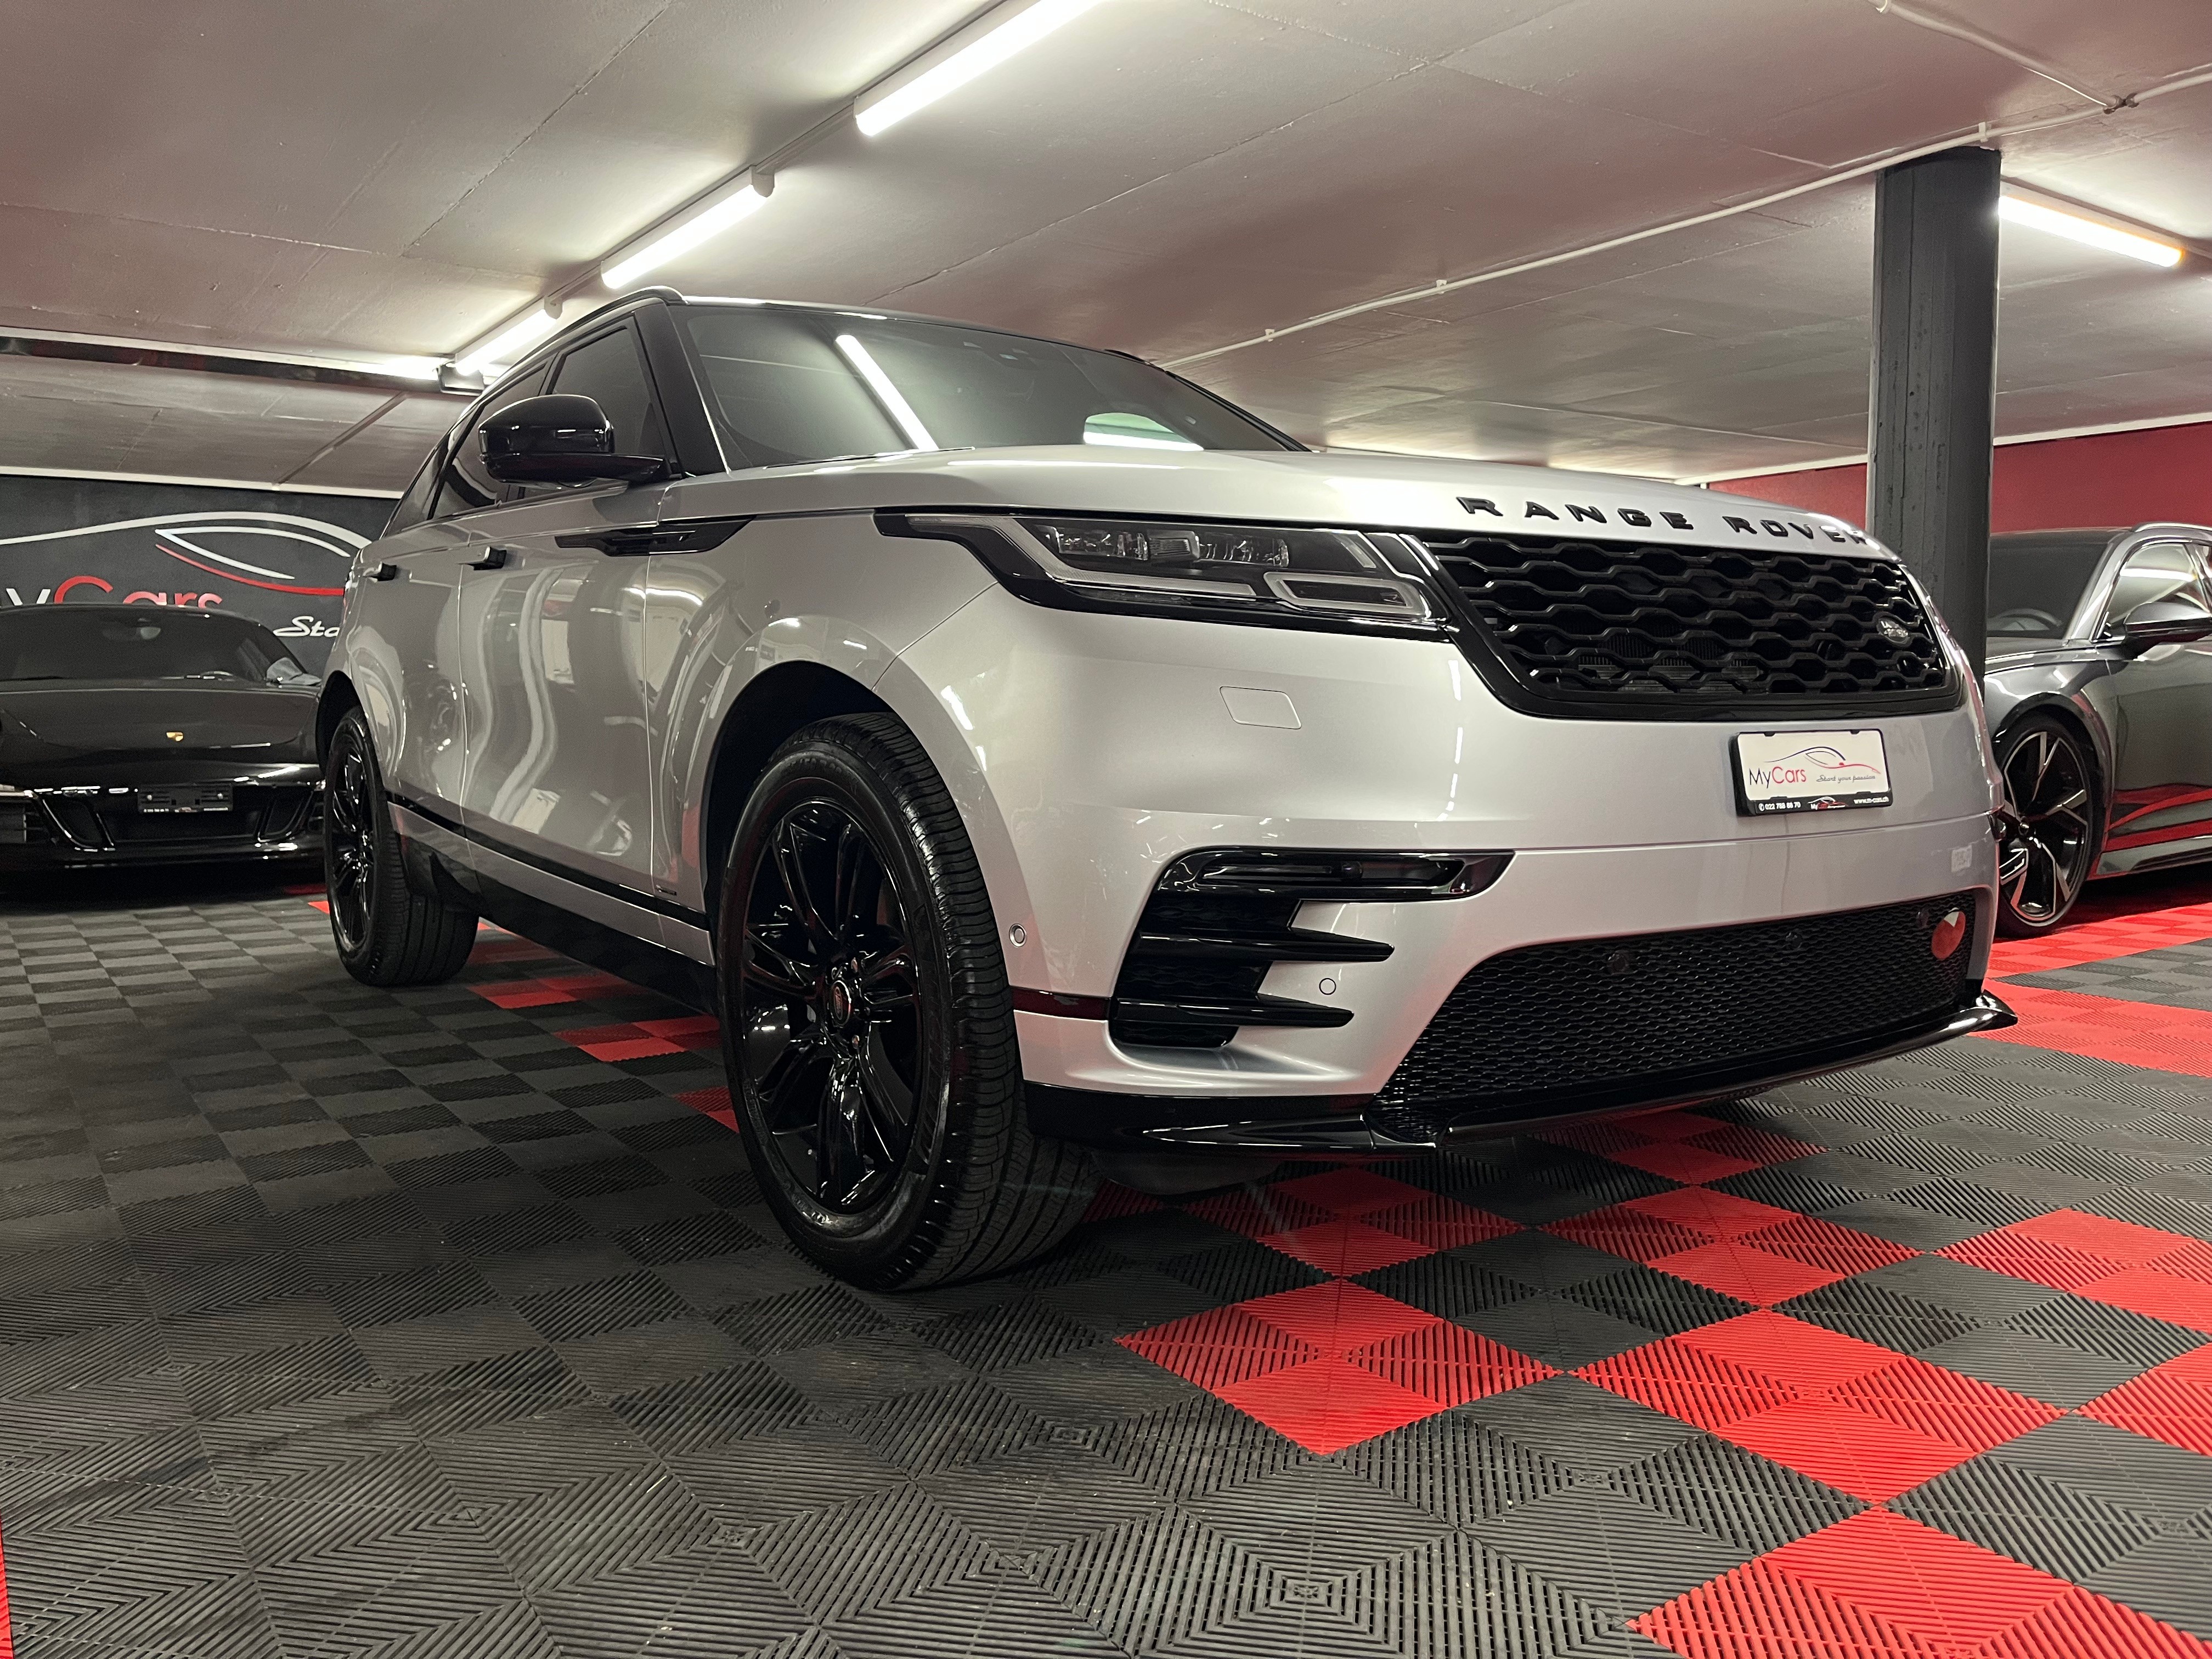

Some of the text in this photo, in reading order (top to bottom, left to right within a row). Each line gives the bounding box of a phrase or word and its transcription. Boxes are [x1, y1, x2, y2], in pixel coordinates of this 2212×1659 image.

[1456, 496, 1694, 530] RANGE
[1748, 766, 1807, 789] MyCars
[1852, 775, 1876, 783] passion
